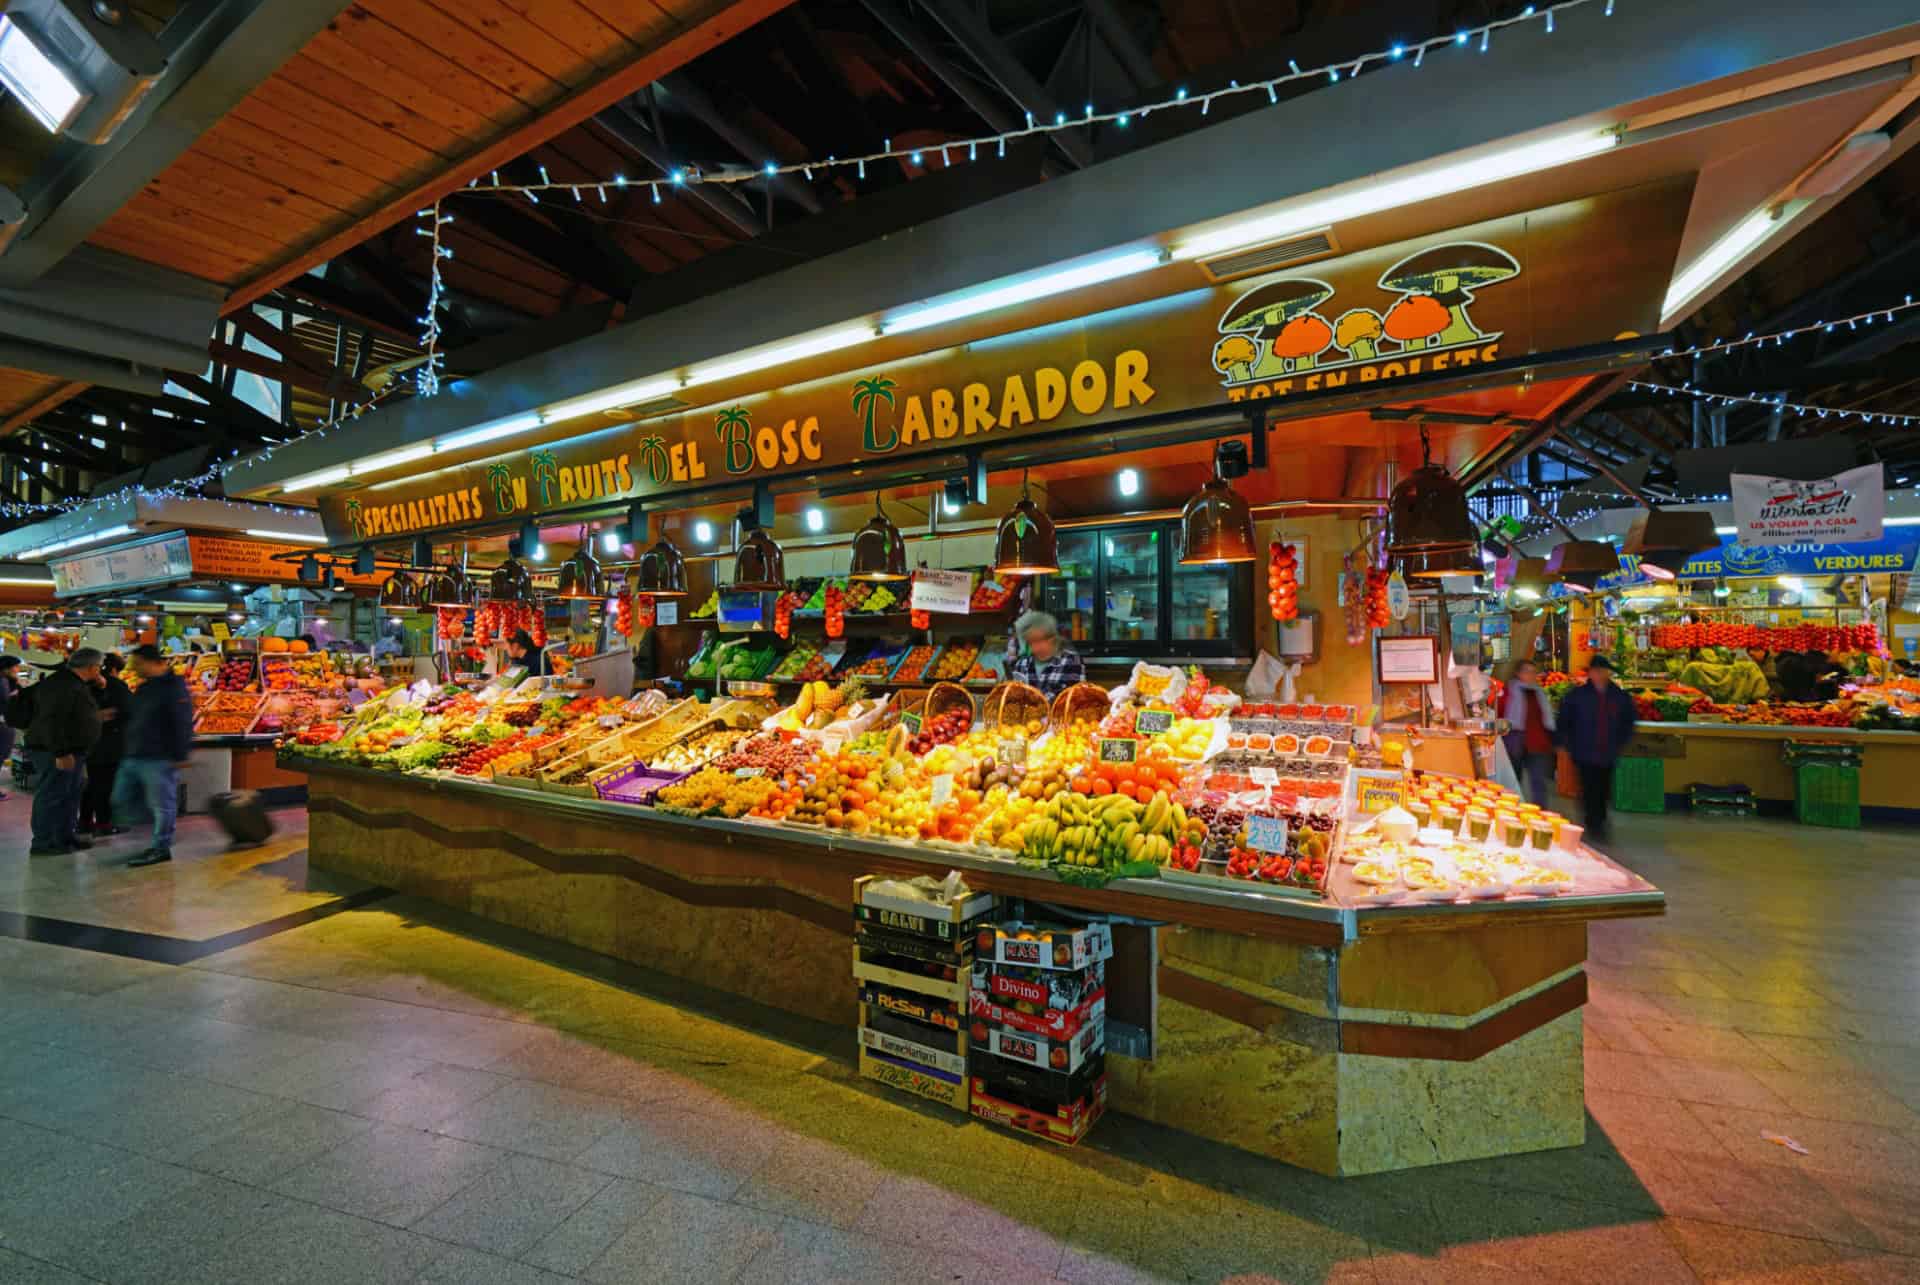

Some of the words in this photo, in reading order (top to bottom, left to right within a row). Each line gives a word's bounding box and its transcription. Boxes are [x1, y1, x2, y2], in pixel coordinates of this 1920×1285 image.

[531, 449, 634, 507] FRUITS
[640, 433, 706, 486] DEL
[714, 404, 823, 474] BOSC
[852, 349, 1157, 454] LABRADOR
[1768, 518, 1809, 529] VOLEM
[1813, 517, 1822, 527] A
[1826, 516, 1857, 527] CASA
[1813, 553, 1904, 570] VERDURES
[998, 978, 1041, 1001] Divino
